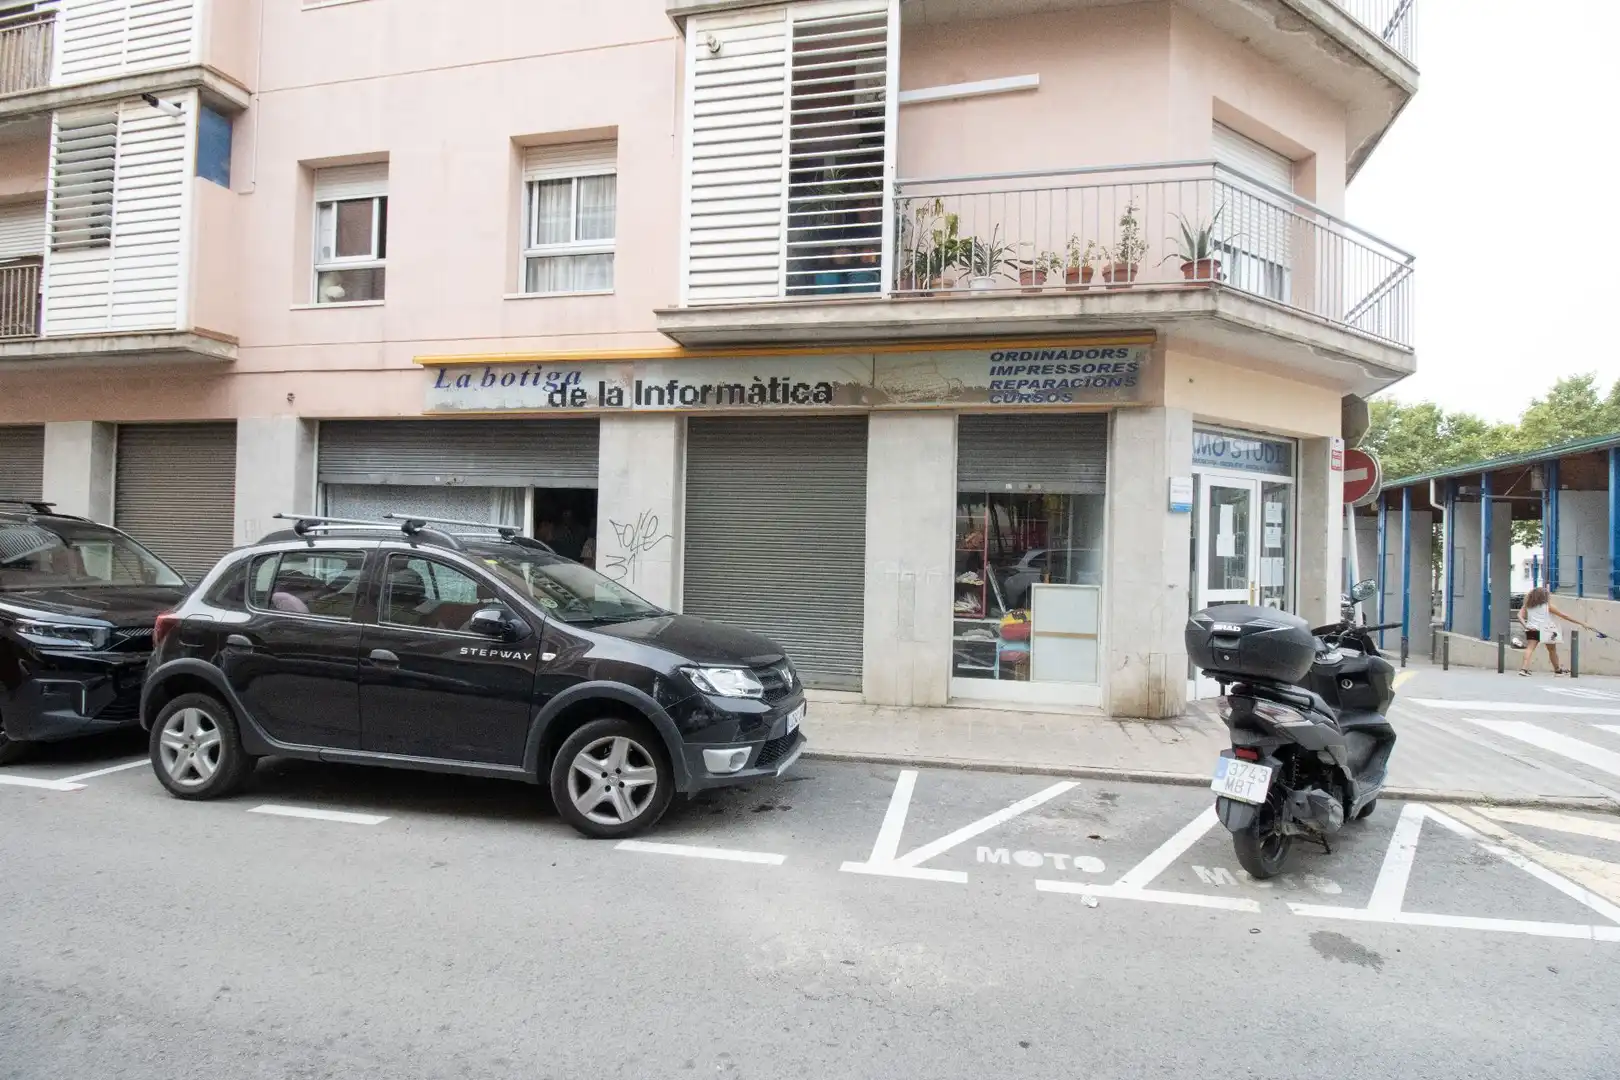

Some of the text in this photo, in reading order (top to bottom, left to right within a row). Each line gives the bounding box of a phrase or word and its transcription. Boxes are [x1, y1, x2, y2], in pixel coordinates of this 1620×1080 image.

[990, 348, 1129, 362] ORDINADORS
[990, 362, 1140, 376] IMPRESSORES
[434, 364, 583, 392] La botiga
[990, 375, 1137, 390] REPARACIONS
[548, 376, 834, 408] de la Informàtica
[990, 390, 1073, 404] CURSOS
[460, 647, 532, 661] STEPWAY
[1229, 763, 1268, 783] 3743
[976, 846, 1106, 873] MOTO
